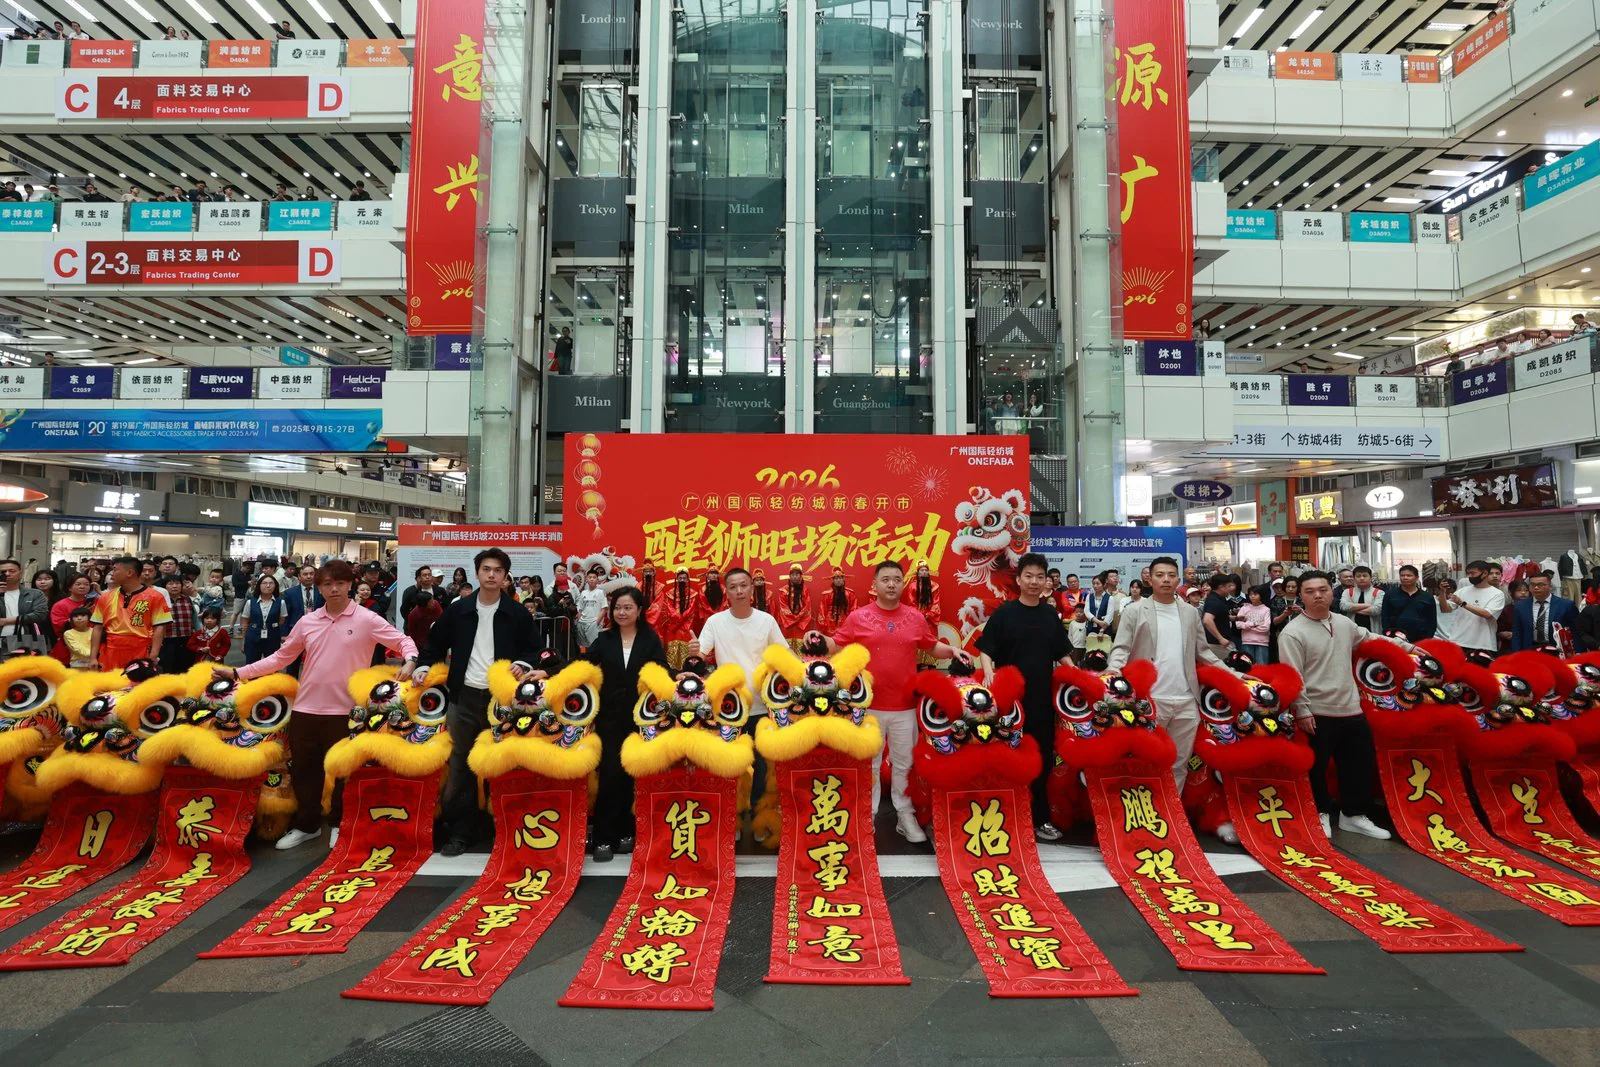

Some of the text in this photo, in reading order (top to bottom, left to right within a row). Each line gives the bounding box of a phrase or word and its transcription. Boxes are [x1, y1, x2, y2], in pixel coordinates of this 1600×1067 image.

[580, 14, 626, 24] London
[157, 84, 251, 97] 面料交易中心
[318, 83, 343, 111] D
[64, 83, 90, 113] C
[113, 87, 142, 110] 4层
[189, 106, 220, 115] Trading
[1441, 170, 1508, 213] Sun Glory
[579, 204, 617, 216] Tokyo
[728, 203, 764, 214] Milan
[985, 207, 1017, 218] Paris
[1422, 221, 1441, 230] 创业
[146, 248, 241, 262] 面料交易中心
[308, 247, 333, 277] D
[53, 248, 79, 278] C
[90, 252, 140, 275] 2-3层
[179, 271, 210, 280] Trading
[1123, 293, 1157, 306] 2026
[1159, 362, 1182, 370] D2001
[69, 375, 95, 385] 东创
[575, 396, 612, 407] Milan
[715, 397, 772, 410] Newyork
[833, 398, 891, 410] Guangzhou
[1297, 433, 1342, 446] 纺城4街
[1357, 433, 1414, 447] 纺城5-6街
[950, 446, 1014, 456] 广州国际轻纺城
[968, 457, 1014, 466] ONEFABA
[755, 463, 841, 490] 2026
[1183, 483, 1211, 497] 楼梯
[683, 494, 911, 511] 广州国际轻纺城新春开市
[1299, 495, 1337, 521] 順豐
[642, 512, 951, 581] 醒狮旺场活动
[804, 773, 863, 964] 萬事如意
[1120, 784, 1255, 952] 鵬程萬里
[620, 799, 711, 984] 貨如輪轉
[962, 798, 1073, 973] 招財進寶
[419, 808, 562, 979] 心想事成
